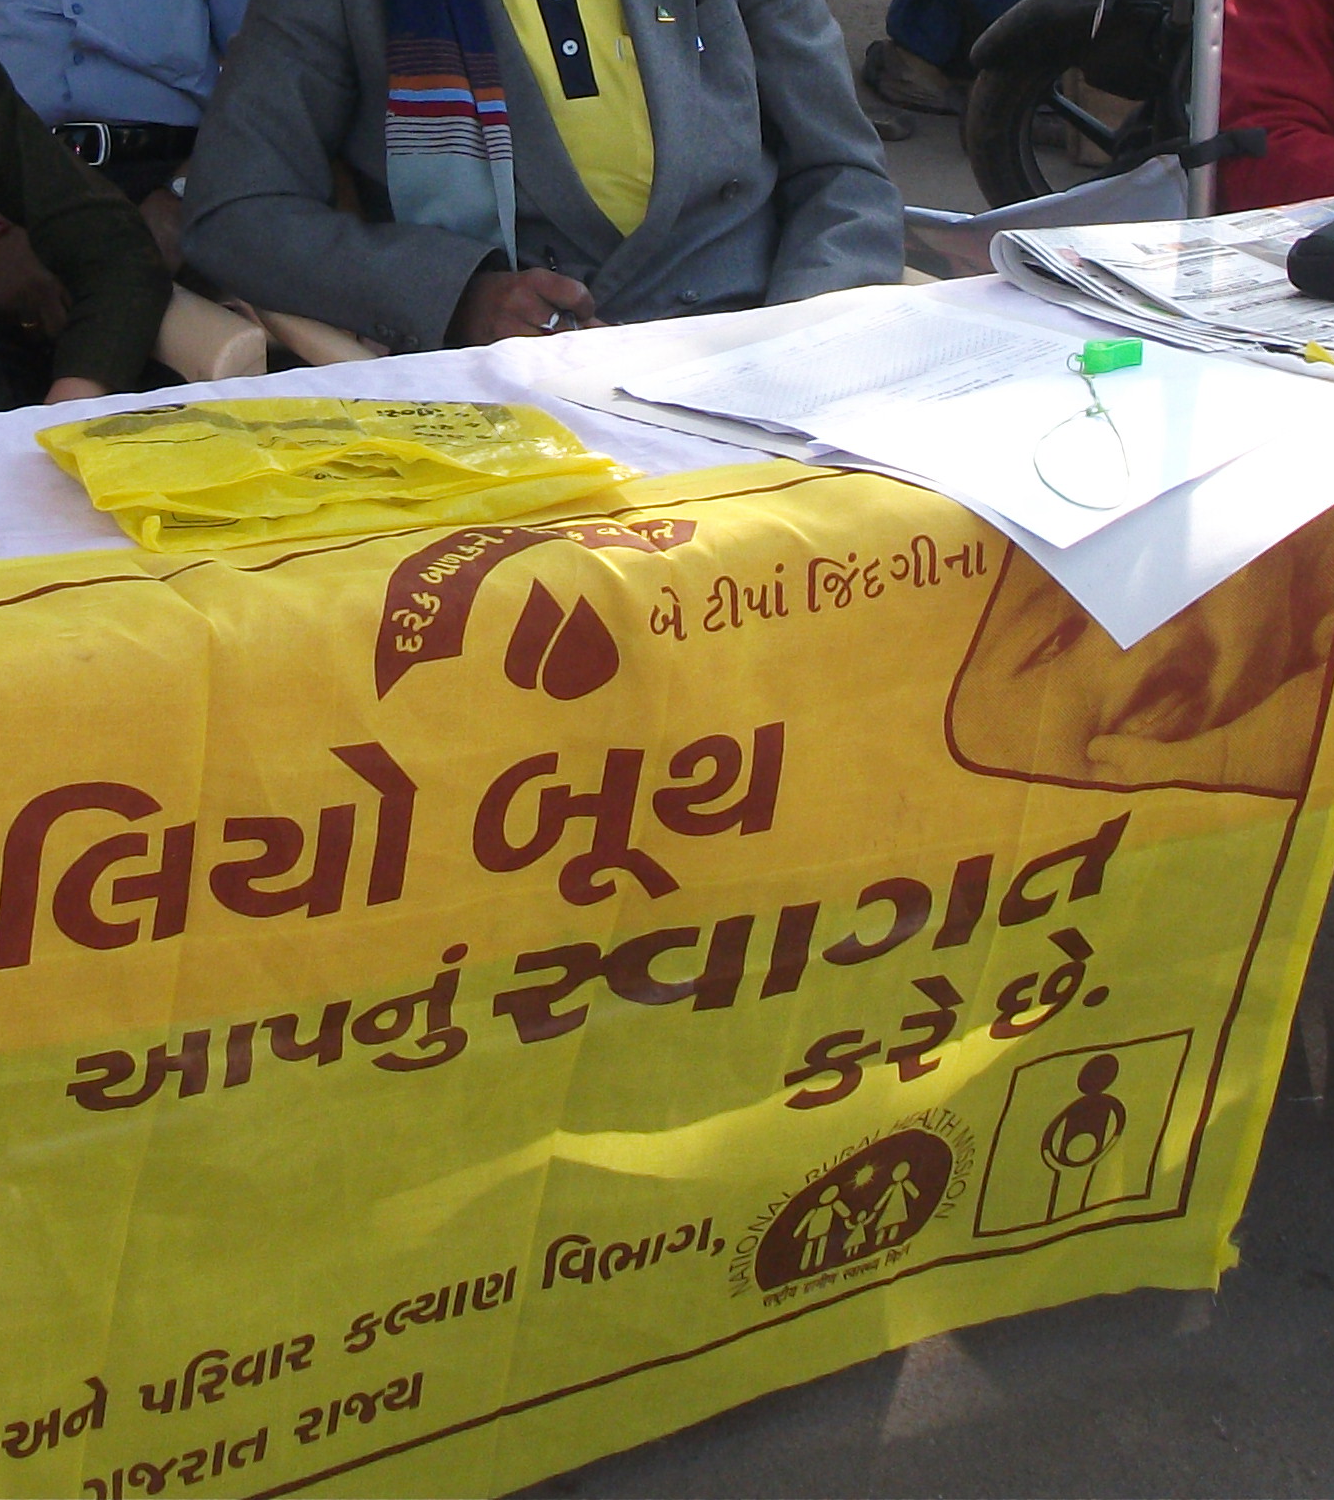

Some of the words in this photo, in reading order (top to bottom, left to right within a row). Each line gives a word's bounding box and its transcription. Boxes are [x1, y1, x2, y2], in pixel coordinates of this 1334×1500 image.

[391, 590, 442, 653] દરેક
[649, 586, 687, 641] બે
[703, 562, 789, 633] ટીપાં
[807, 534, 988, 613] જિંદગીના
[472, 721, 785, 906] બૂથ
[66, 943, 469, 1112] આપનું
[492, 810, 1132, 1044] સ્વાગત
[784, 975, 965, 1110] કરે
[989, 927, 1110, 1040] છે.
[729, 1191, 792, 1299] NATIONAL
[935, 1125, 976, 1220] MISSION
[1, 1376, 109, 1459] અને
[139, 1333, 316, 1414] પરિવાર
[344, 1266, 518, 1354] કલ્યાણ
[541, 1217, 726, 1290] વિભાગ,
[83, 1427, 268, 1500] ગજરાત
[293, 1372, 425, 1446] રાજ્ય
